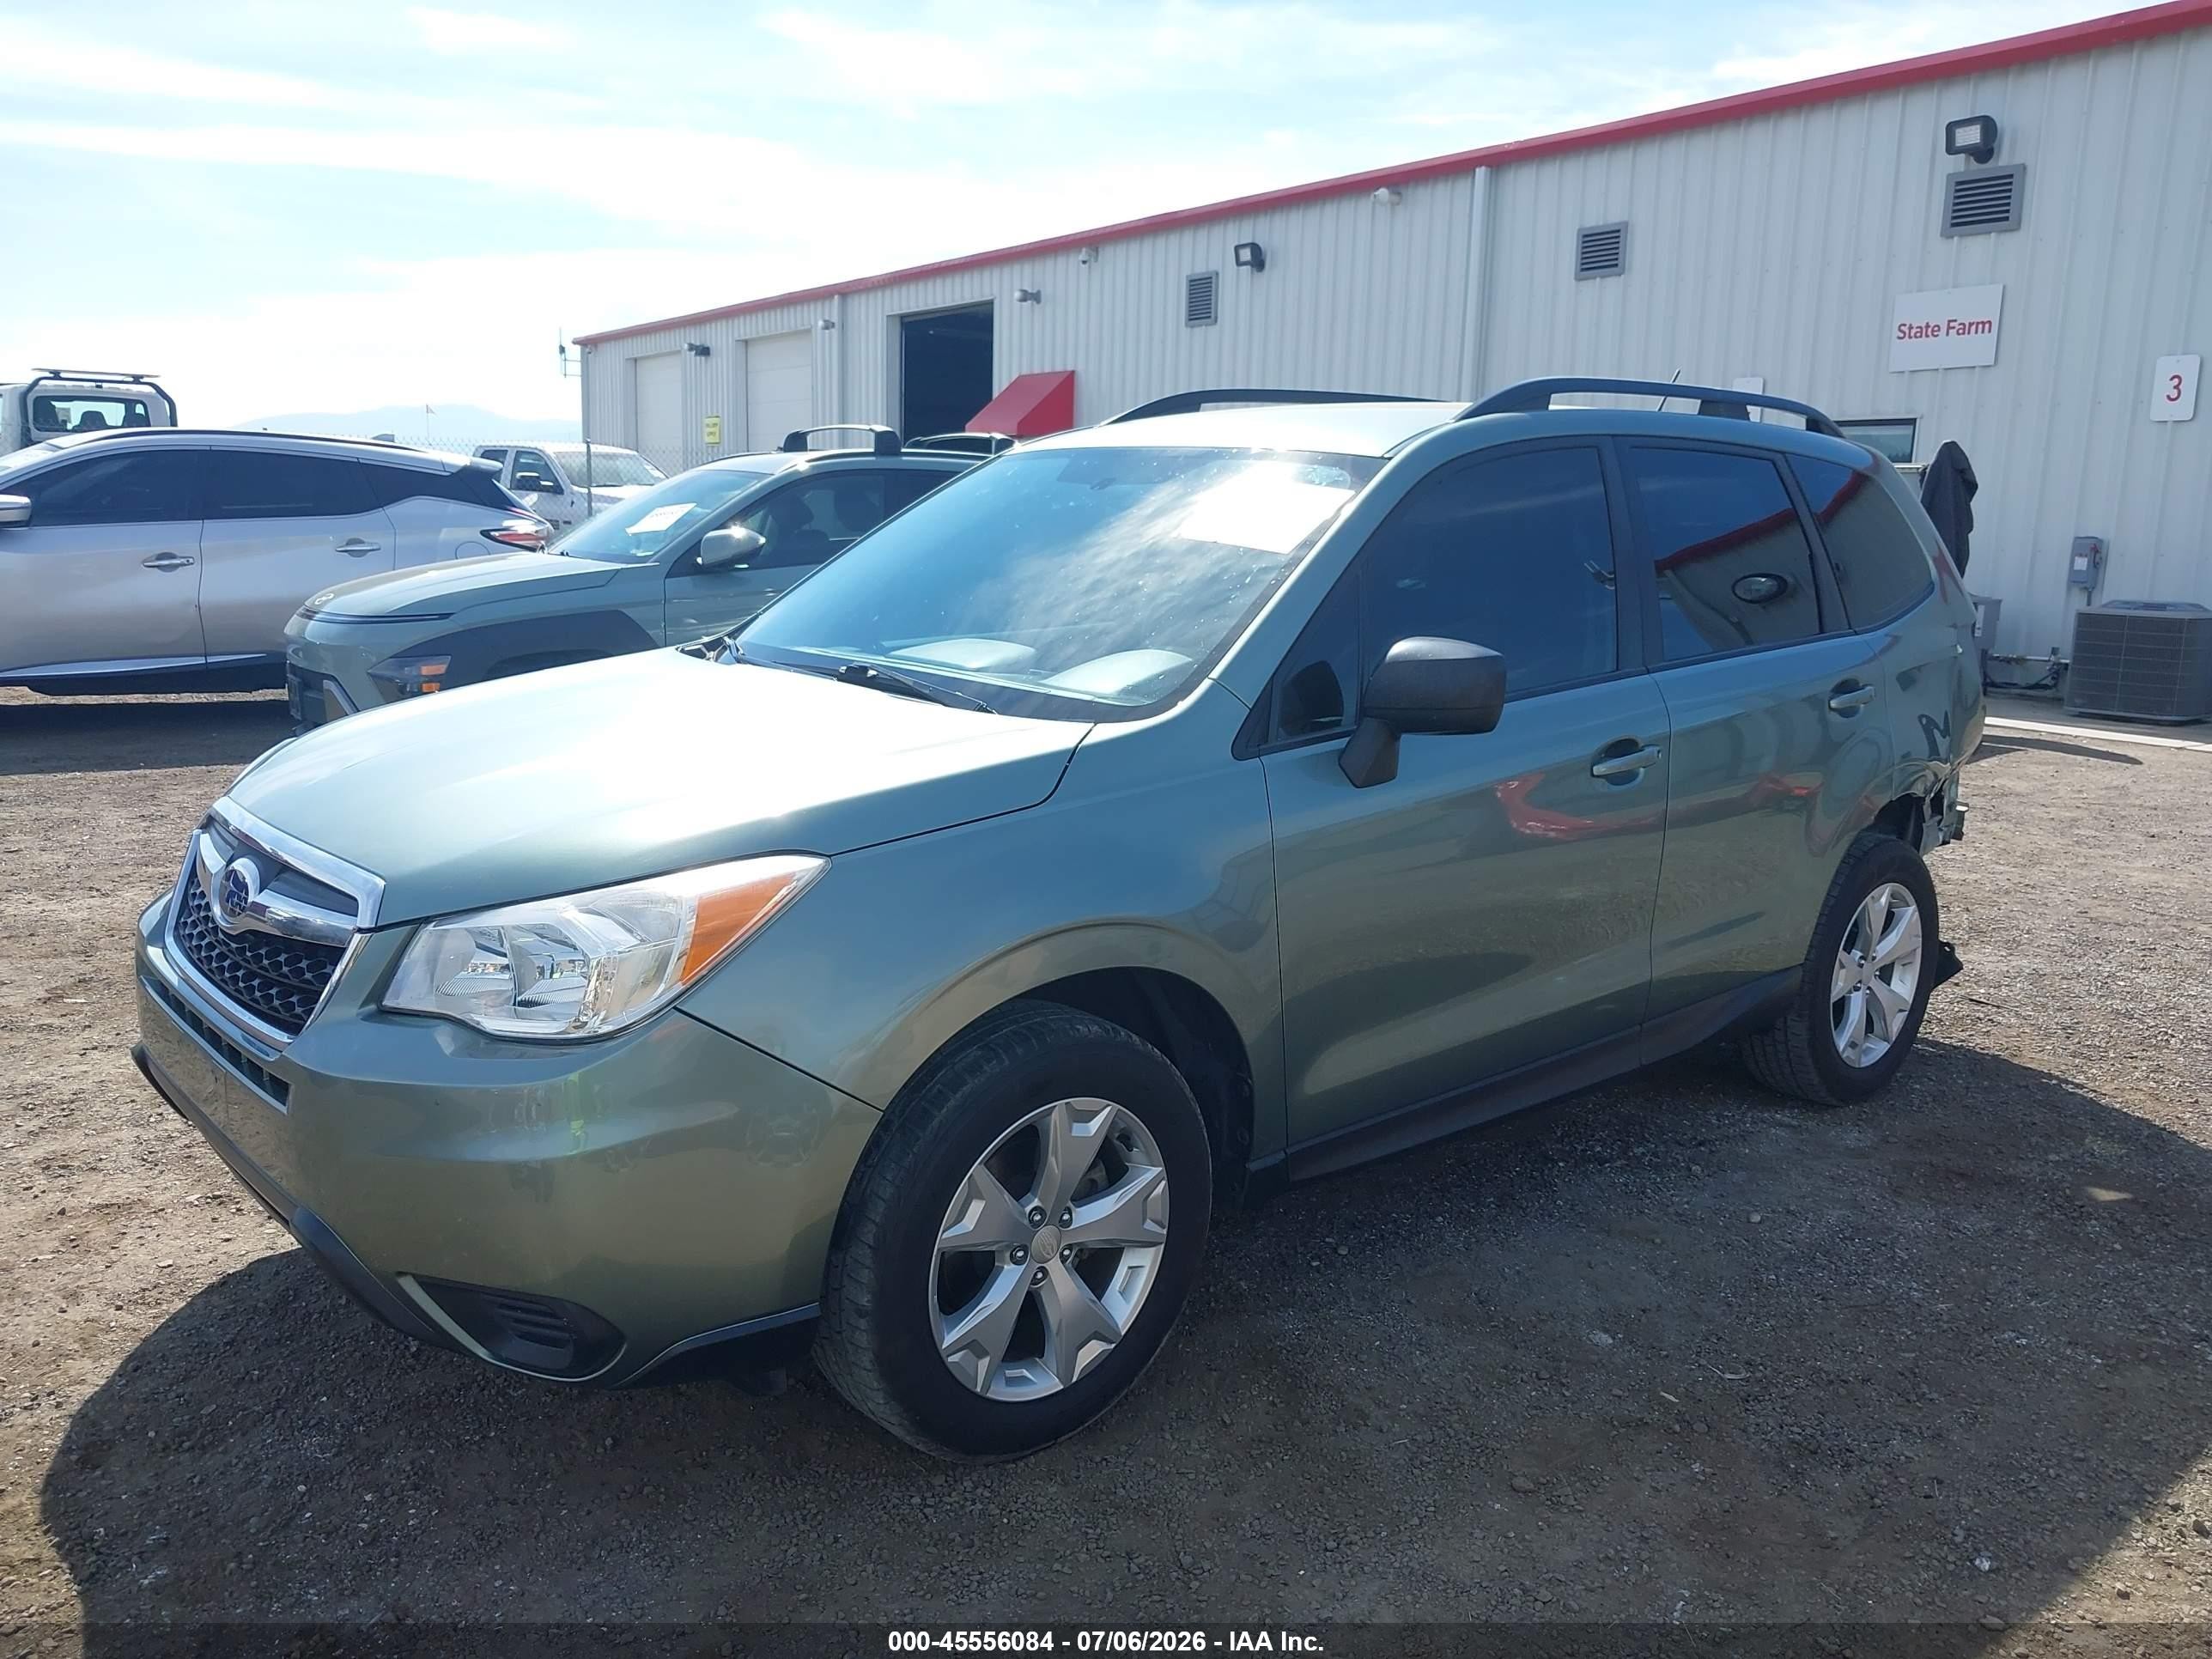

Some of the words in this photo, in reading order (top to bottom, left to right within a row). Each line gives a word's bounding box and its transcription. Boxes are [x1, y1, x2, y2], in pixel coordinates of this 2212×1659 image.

[1896, 321, 1941, 340] State
[1945, 319, 1993, 337] Farm
[2166, 374, 2183, 402] 3
